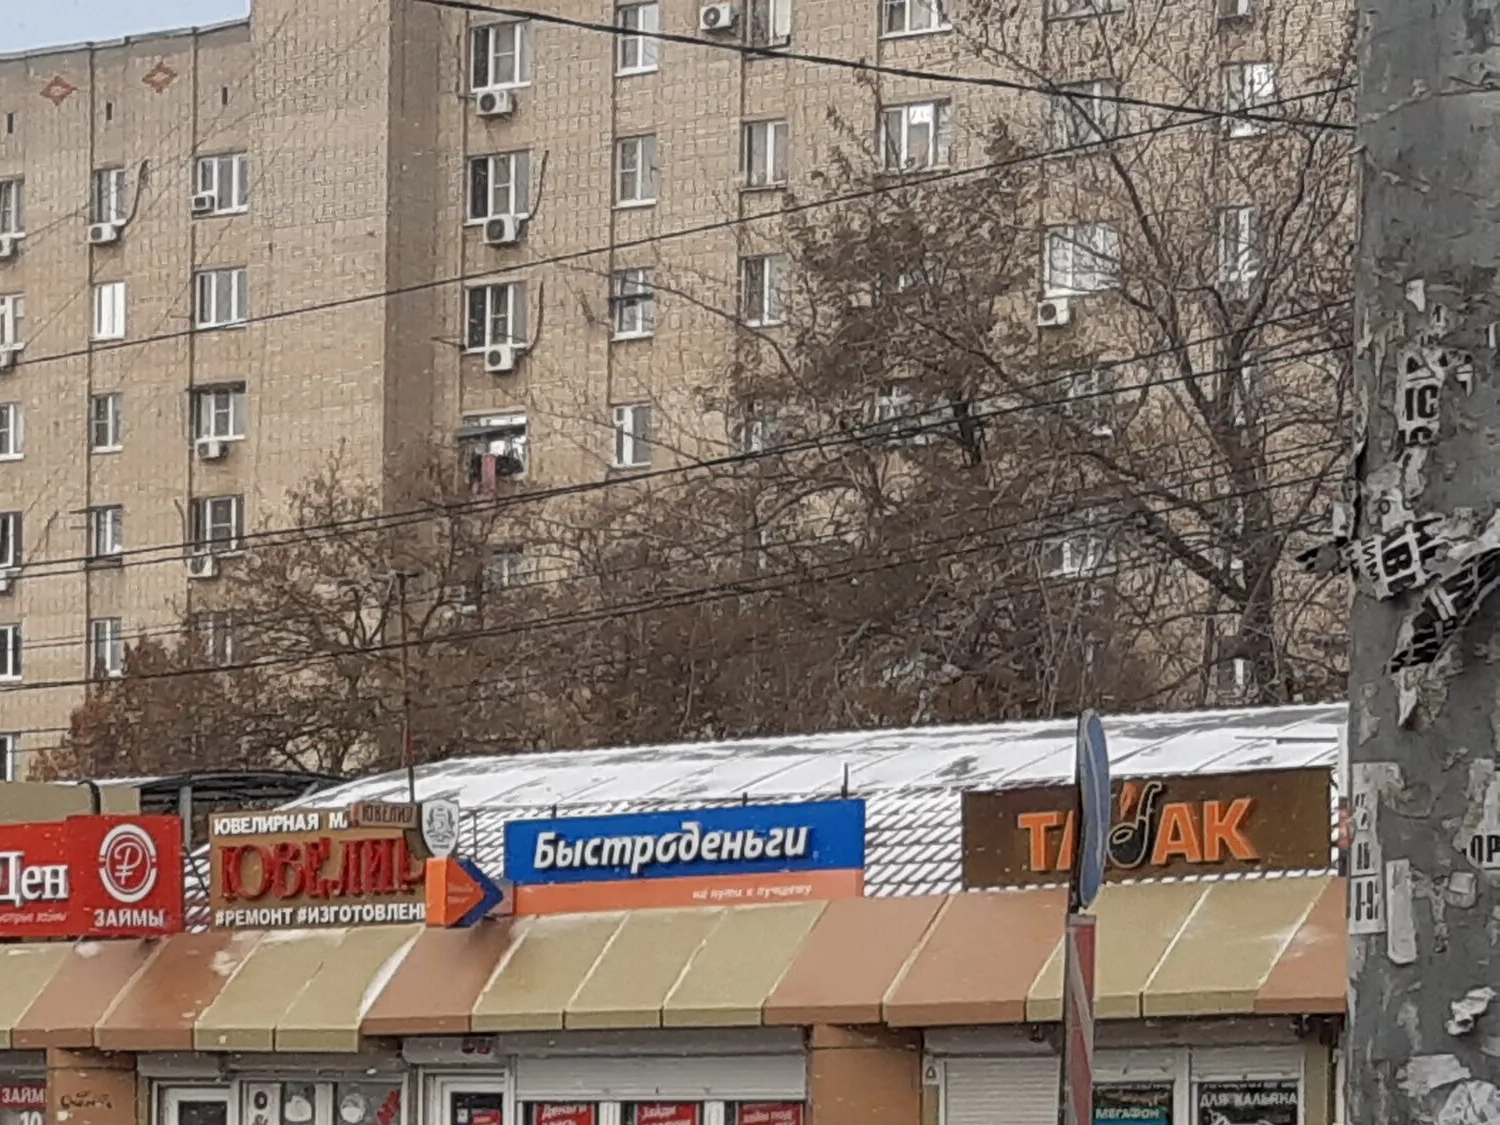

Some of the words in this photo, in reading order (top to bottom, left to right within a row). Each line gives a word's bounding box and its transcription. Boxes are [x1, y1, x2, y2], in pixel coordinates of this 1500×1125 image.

[214, 813, 319, 835] ЮВЕЛИРНАЯ
[534, 822, 810, 874] Быстроденьги
[94, 909, 164, 927] ЗАЙМЫ
[215, 907, 293, 926] #РЕМОНТ
[2, 1087, 46, 1103] ЗАЙМ
